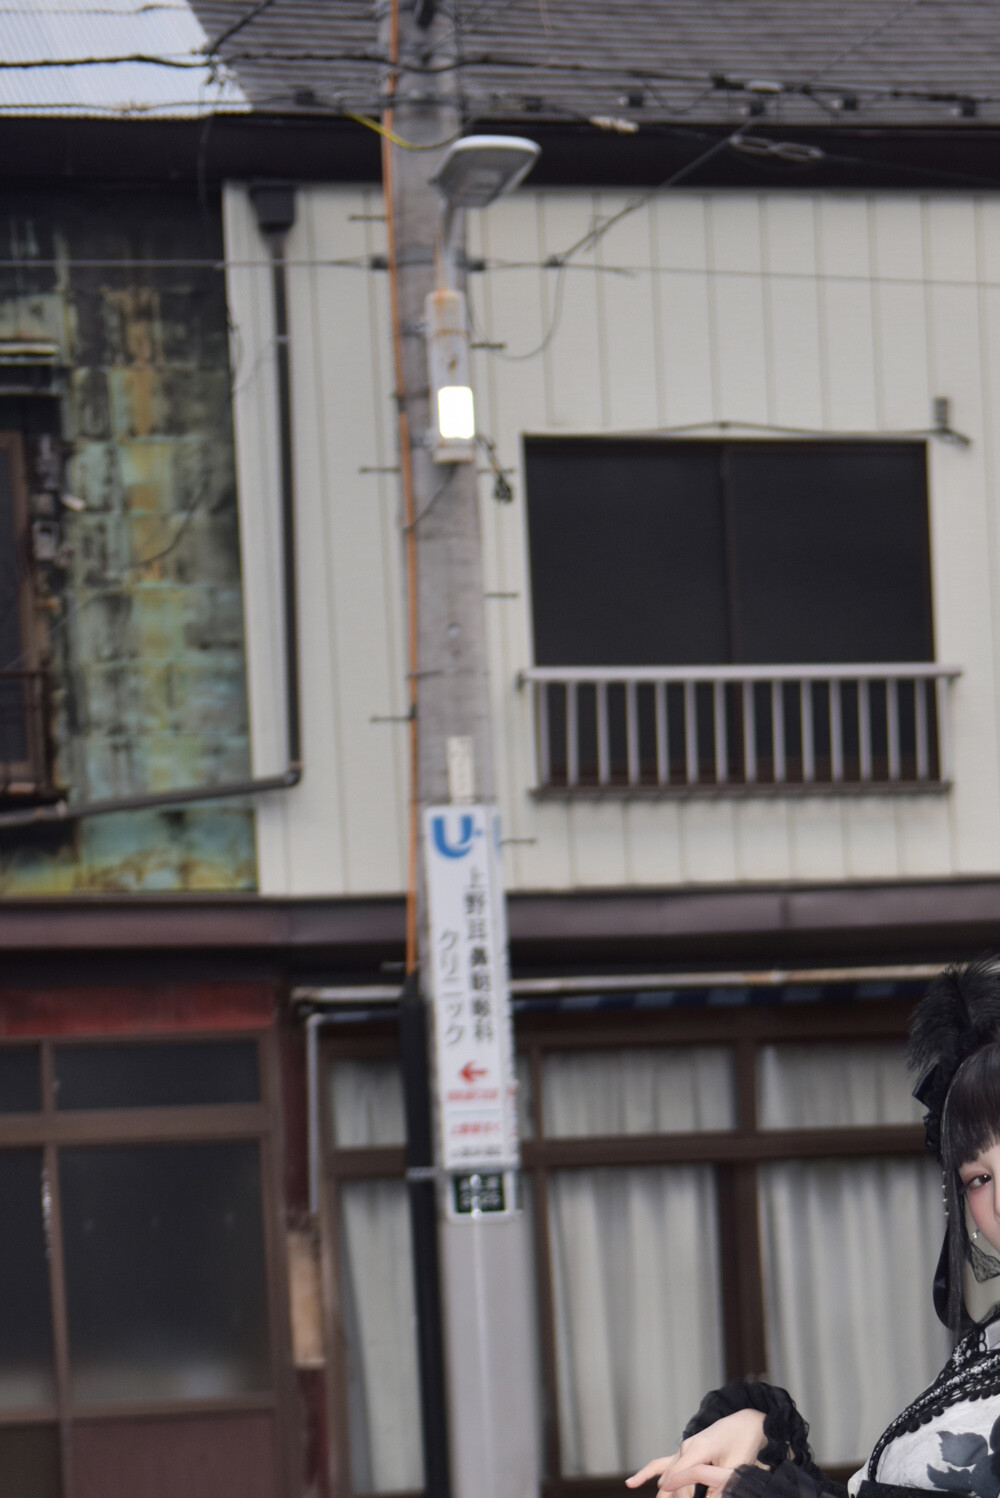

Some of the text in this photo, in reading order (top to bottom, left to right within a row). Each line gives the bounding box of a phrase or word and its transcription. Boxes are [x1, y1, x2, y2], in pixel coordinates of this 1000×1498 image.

[438, 929, 464, 1045] クリニック
